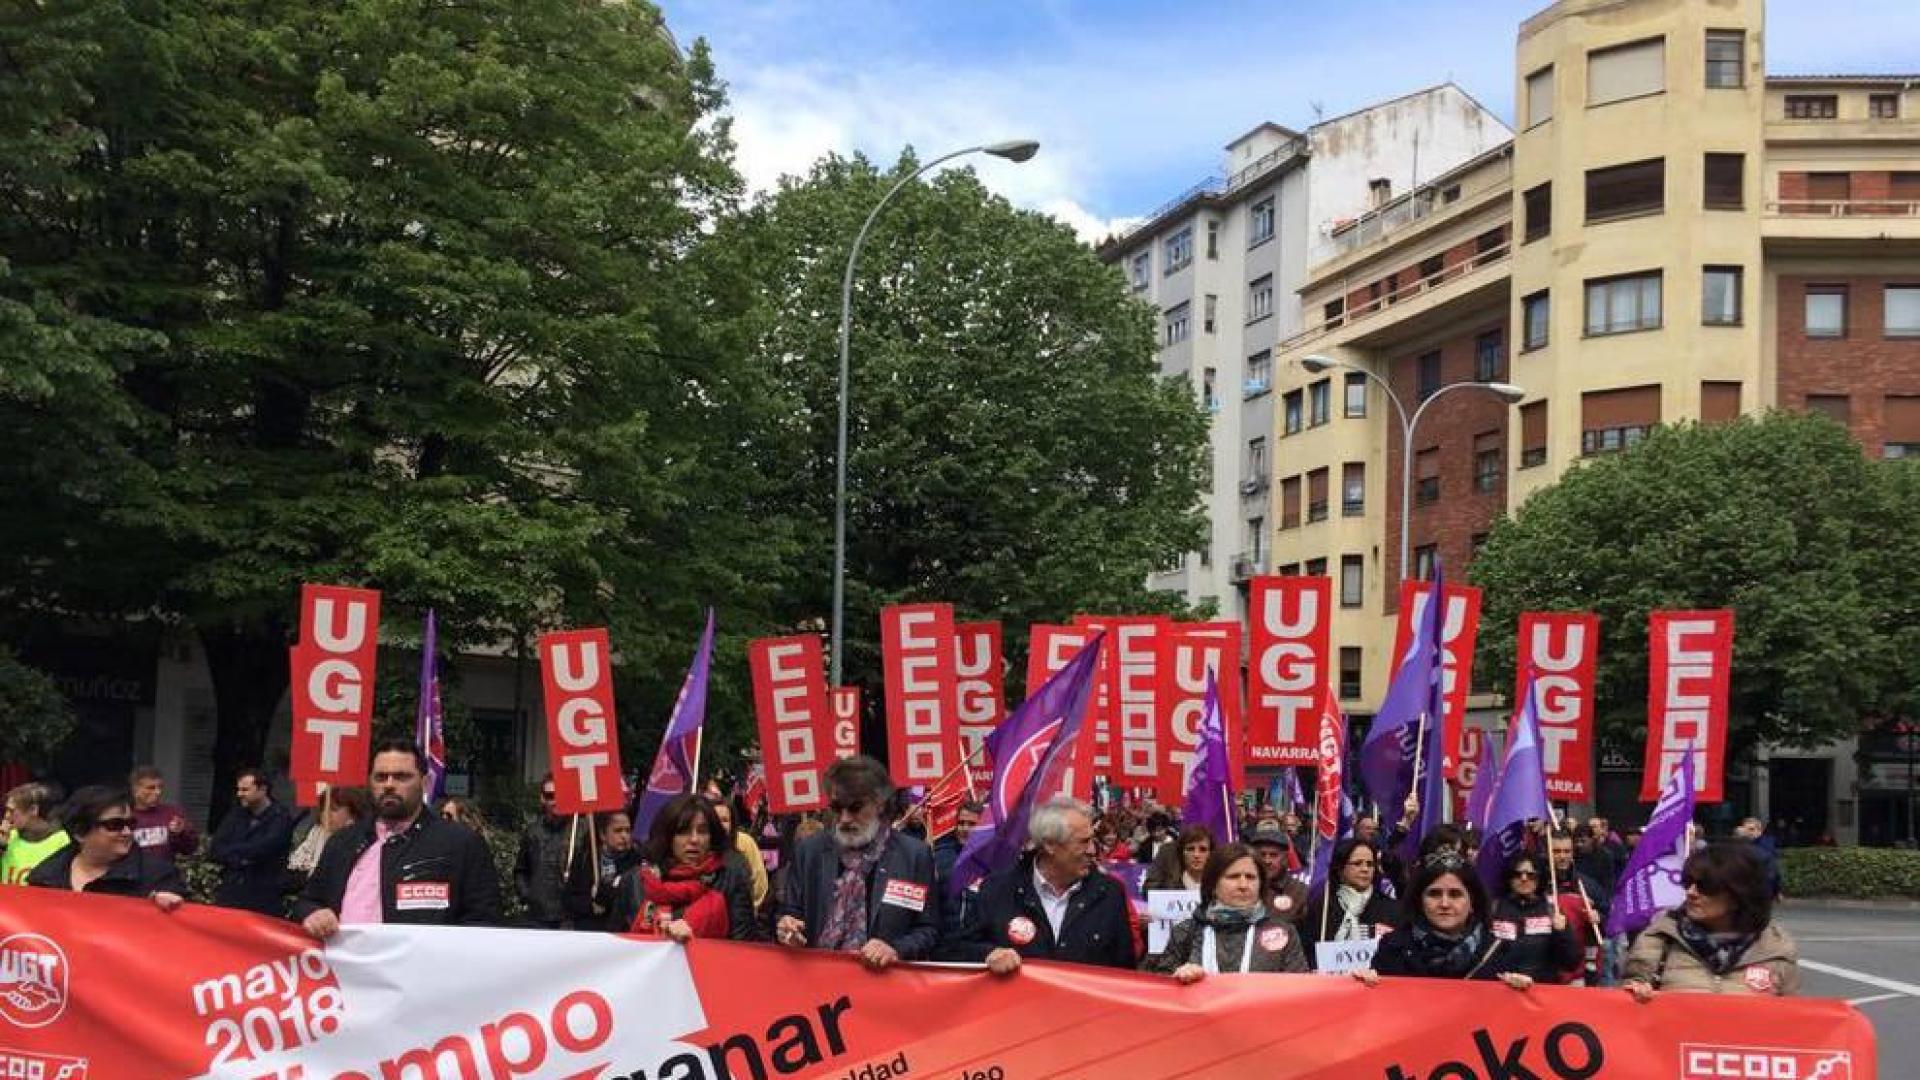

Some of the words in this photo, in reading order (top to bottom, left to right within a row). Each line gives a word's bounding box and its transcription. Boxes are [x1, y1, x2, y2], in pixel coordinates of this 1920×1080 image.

[306, 599, 367, 772] UGT
[551, 641, 609, 802] UGT
[768, 643, 820, 806] CCOO
[900, 612, 944, 779] CCOO
[954, 634, 996, 767] UGT
[1118, 625, 1157, 776] CCOO
[1260, 589, 1318, 743] UGT
[1532, 624, 1585, 774] UGT
[1658, 620, 1716, 791] CCOO
[1252, 746, 1319, 760] NAVARRA
[1546, 780, 1584, 794] ARRA
[0, 950, 58, 989] UGT
[192, 949, 330, 1015] mayo
[205, 987, 343, 1066] 2018
[610, 996, 851, 1080] anar
[1689, 1052, 1796, 1078] CCOO
